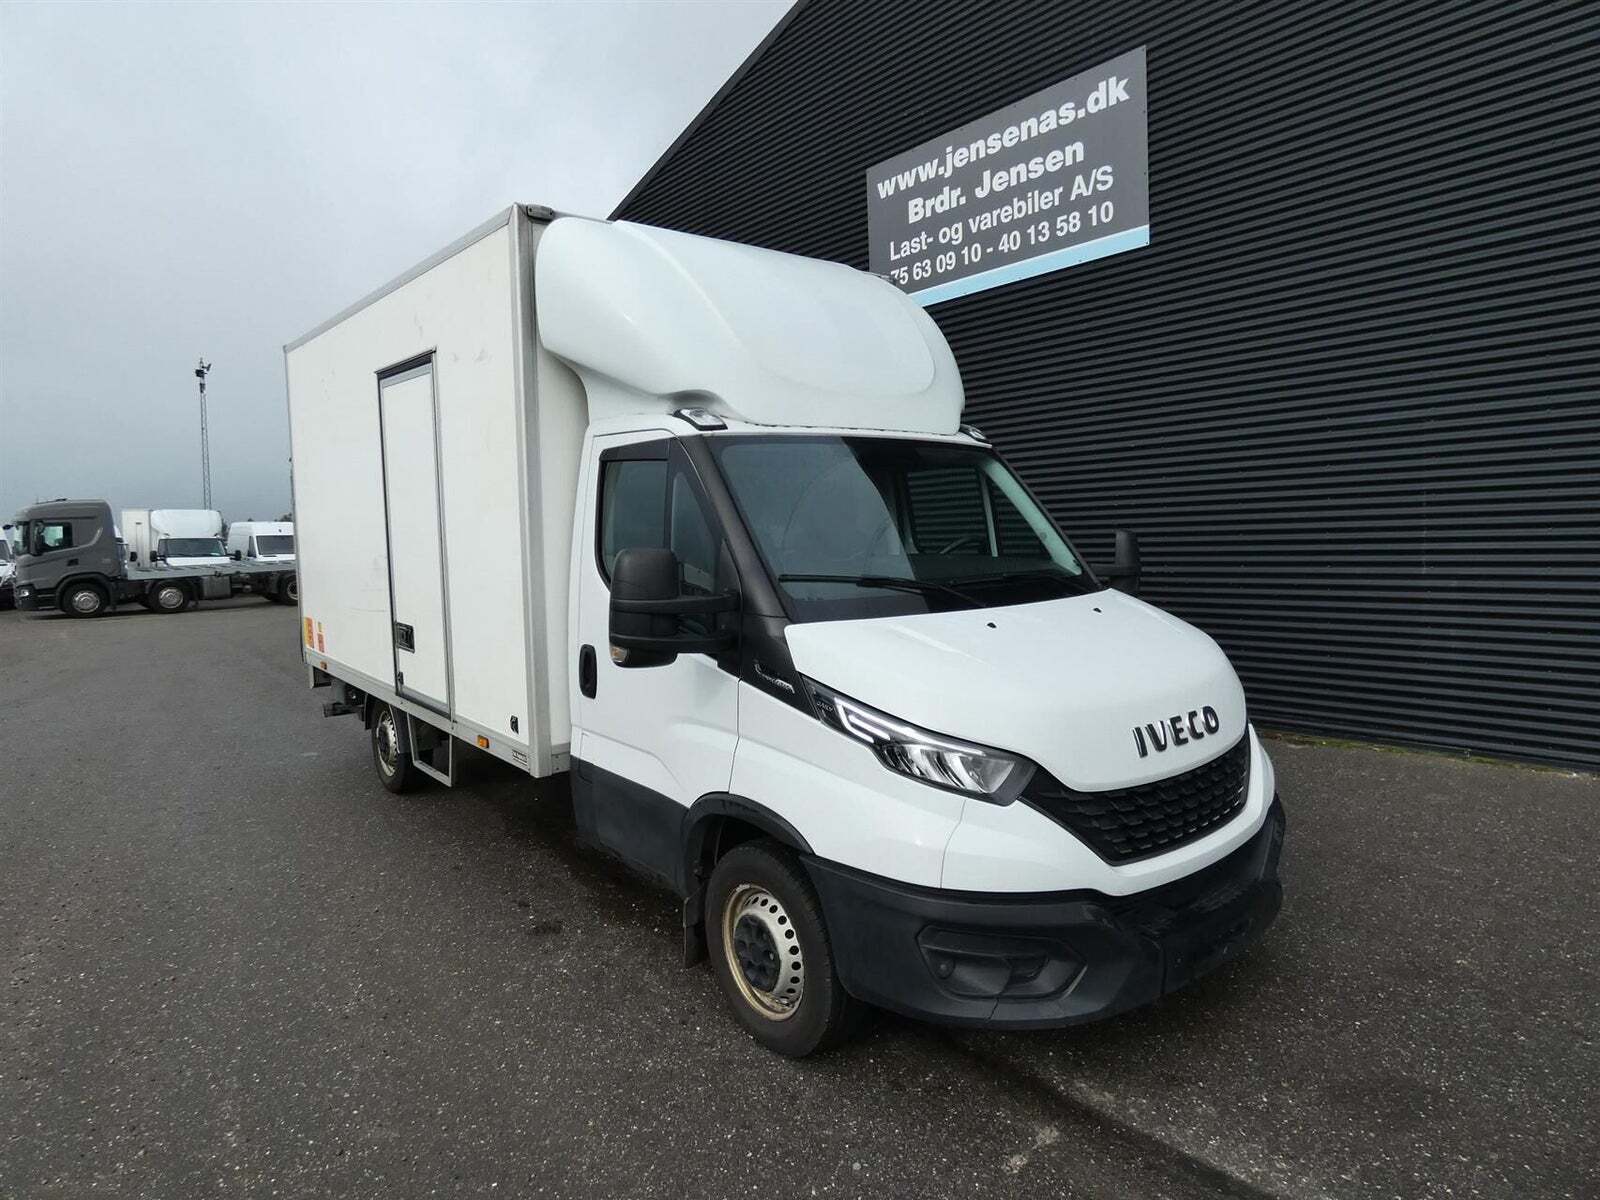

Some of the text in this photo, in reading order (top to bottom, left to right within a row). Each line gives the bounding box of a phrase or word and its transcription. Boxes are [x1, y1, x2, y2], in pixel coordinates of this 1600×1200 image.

[877, 76, 1130, 199] www.jensenas.dk
[890, 165, 1114, 261] Last- og varebiler A/S
[908, 141, 1084, 224] Brdr. Jensen
[913, 259, 932, 280] 63
[936, 251, 956, 273] 09
[961, 243, 981, 266] 10
[999, 231, 1021, 253] 40
[1027, 222, 1050, 245] 13
[1056, 212, 1081, 237] 58
[1088, 201, 1114, 226] 10
[1132, 705, 1219, 758] IVECO
